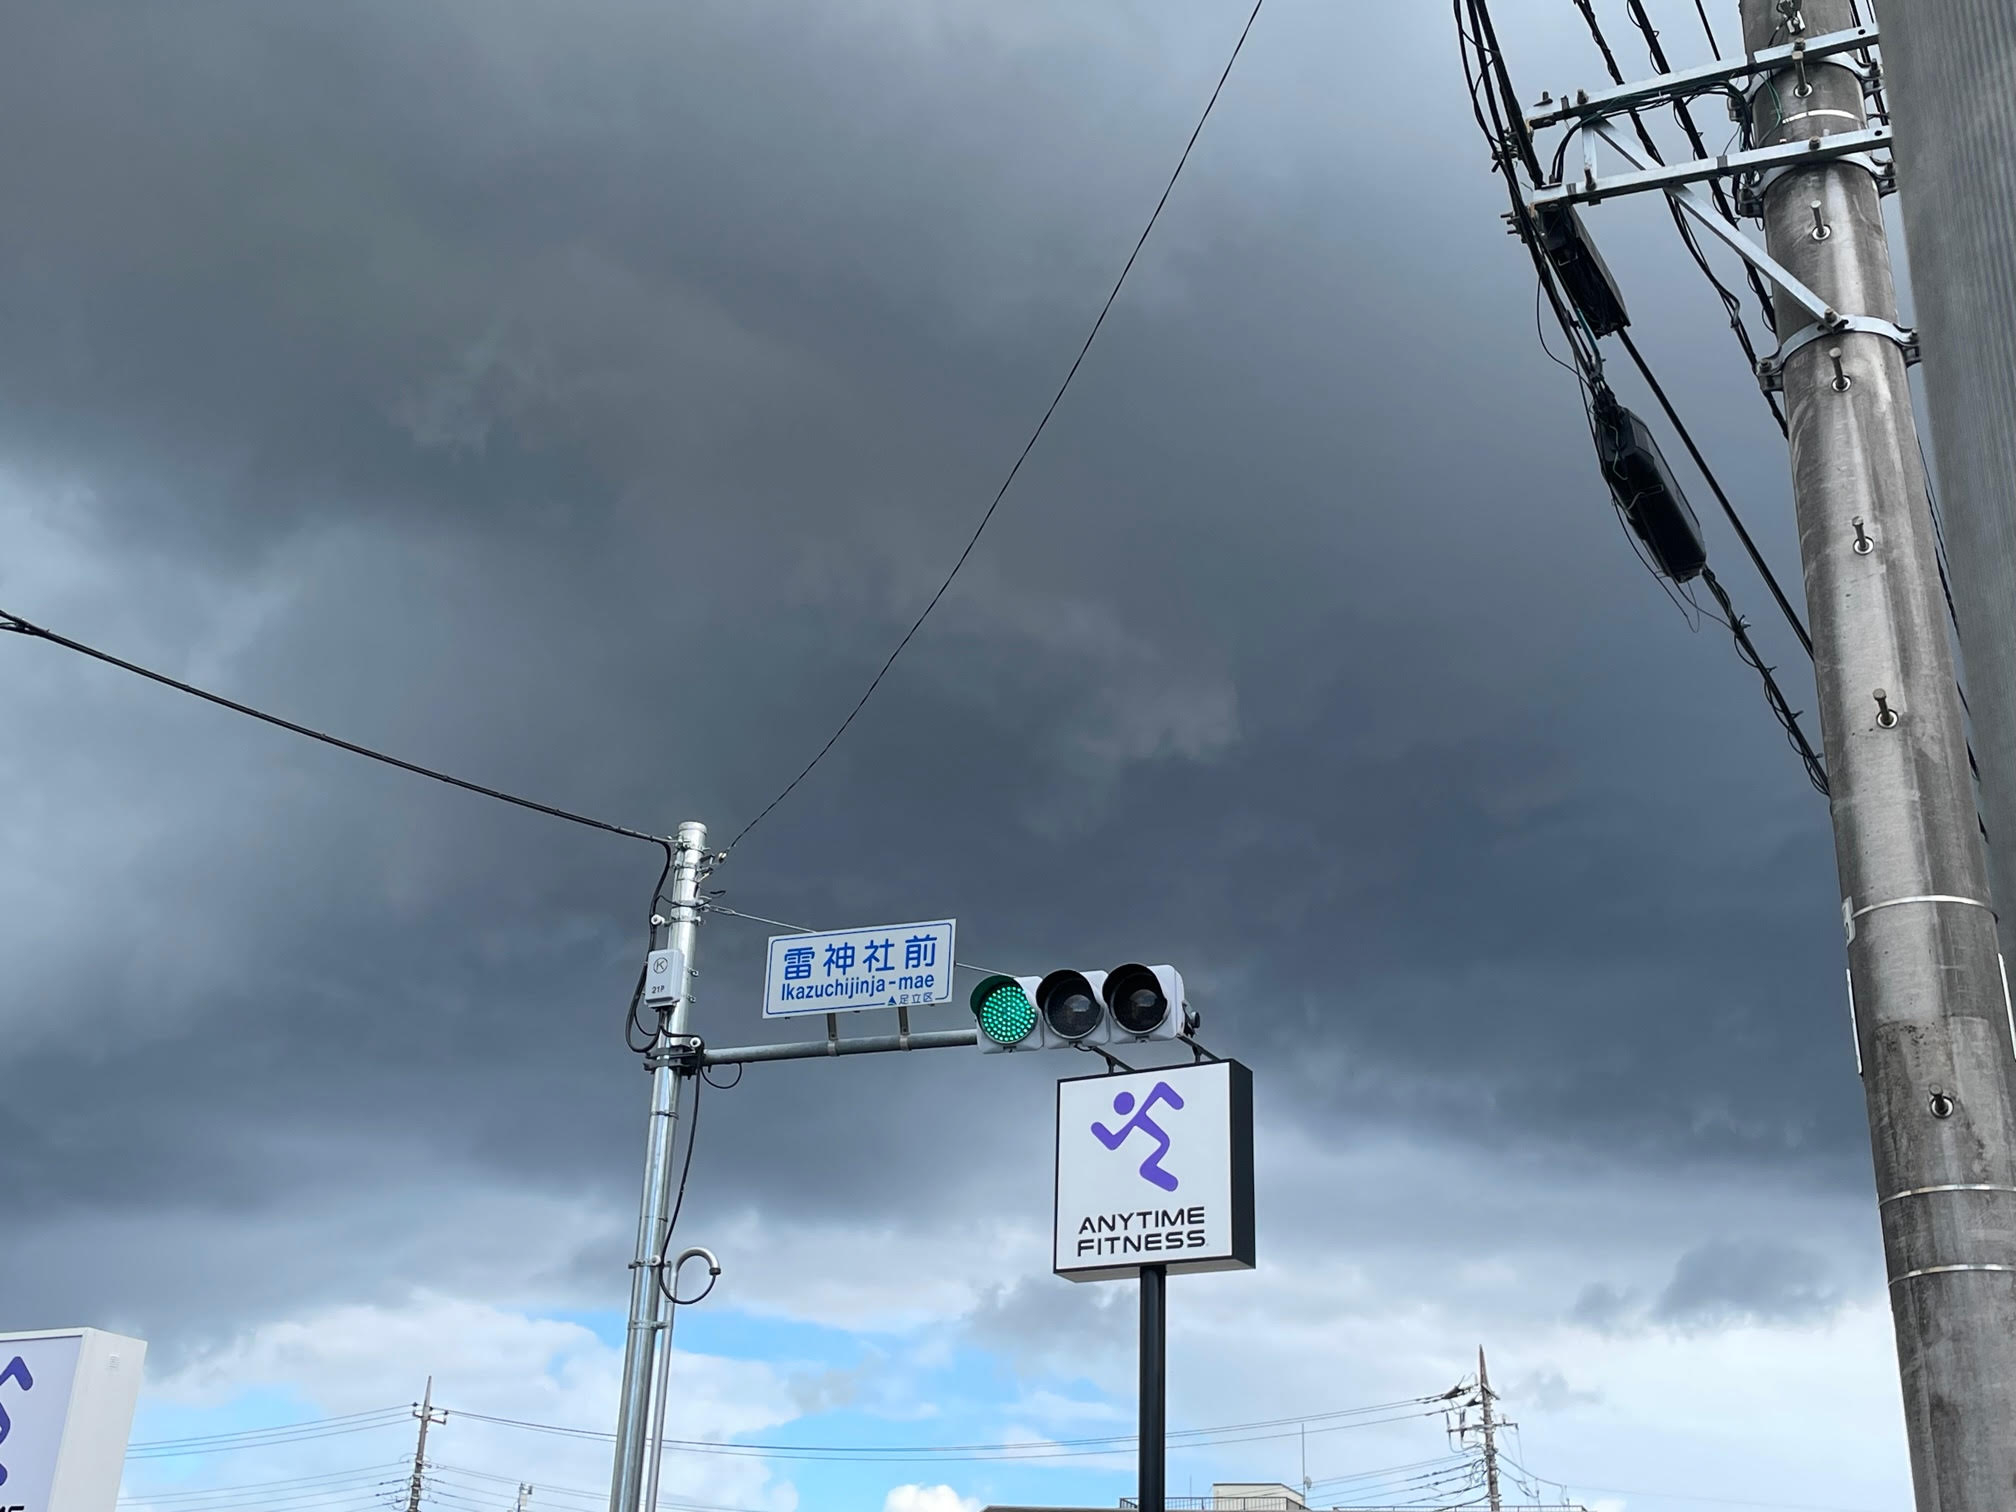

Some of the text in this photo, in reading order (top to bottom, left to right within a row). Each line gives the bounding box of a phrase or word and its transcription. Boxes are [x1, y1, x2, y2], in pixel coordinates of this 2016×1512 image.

[655, 959, 666, 971] K
[784, 934, 938, 981] 雷神社前
[781, 974, 934, 1002] Ikazuchijinja-mae
[898, 991, 934, 1005] 足立区
[1079, 1206, 1205, 1235] ANYTIME
[1077, 1229, 1206, 1257] FITNESS
